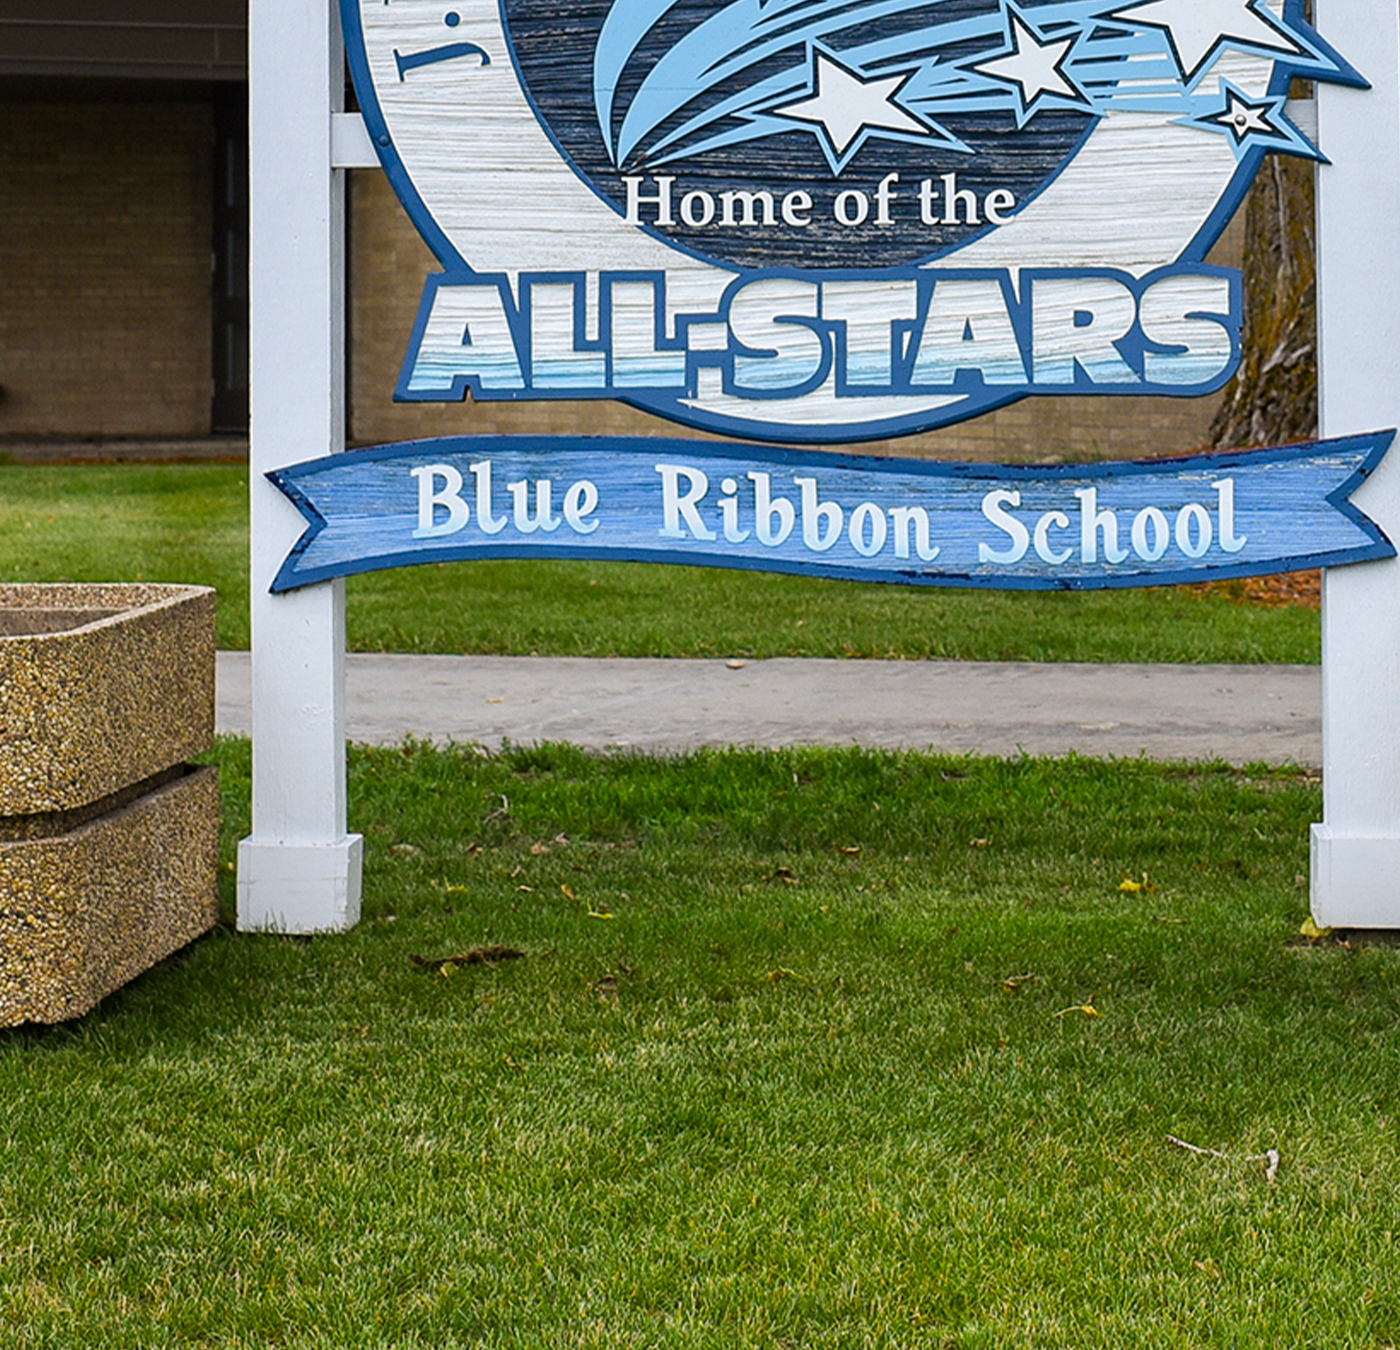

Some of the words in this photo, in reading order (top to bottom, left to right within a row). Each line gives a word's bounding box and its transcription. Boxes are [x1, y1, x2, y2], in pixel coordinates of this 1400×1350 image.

[622, 176, 812, 227] Home
[832, 174, 896, 226] of
[918, 173, 1018, 225] the
[410, 275, 1231, 397] ALL-STARS
[410, 461, 601, 539] Blue
[656, 463, 940, 562] Ribbon
[977, 479, 1246, 567] School
